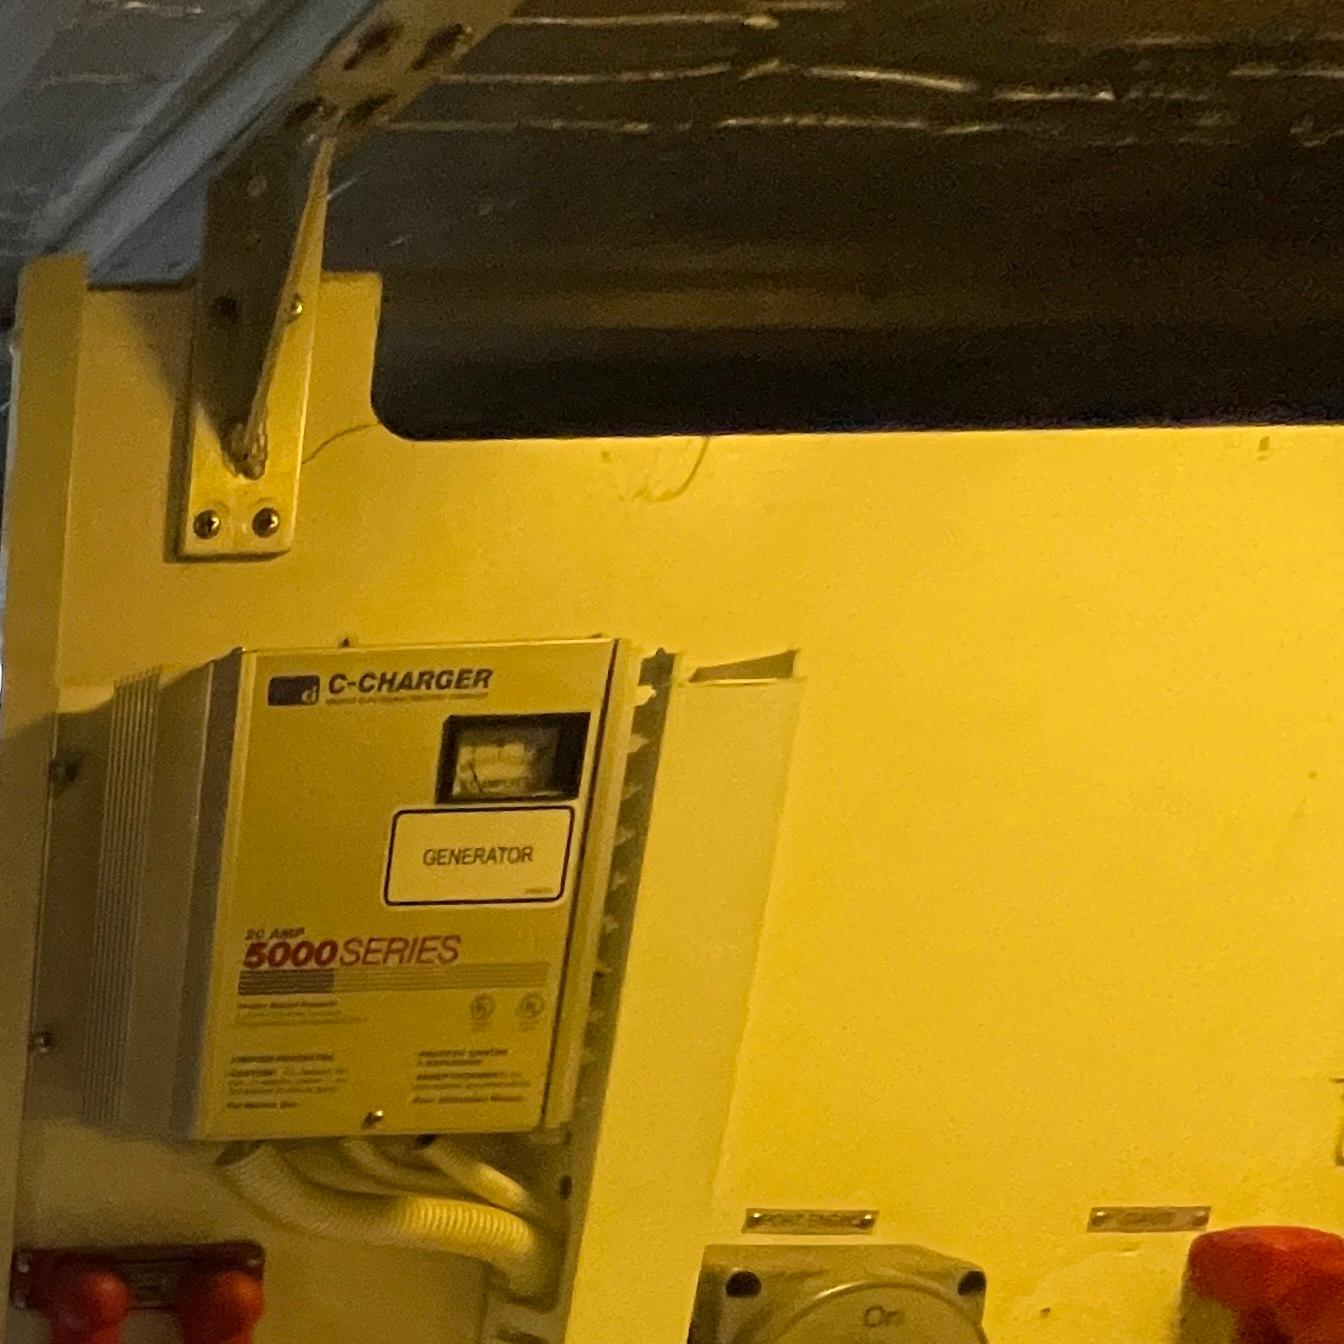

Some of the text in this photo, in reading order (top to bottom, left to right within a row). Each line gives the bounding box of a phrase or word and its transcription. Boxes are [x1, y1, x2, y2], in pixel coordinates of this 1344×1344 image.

[328, 668, 494, 694] C-CHARGER
[422, 846, 534, 866] GENERATOR
[243, 935, 462, 969] 5000 SERIES
